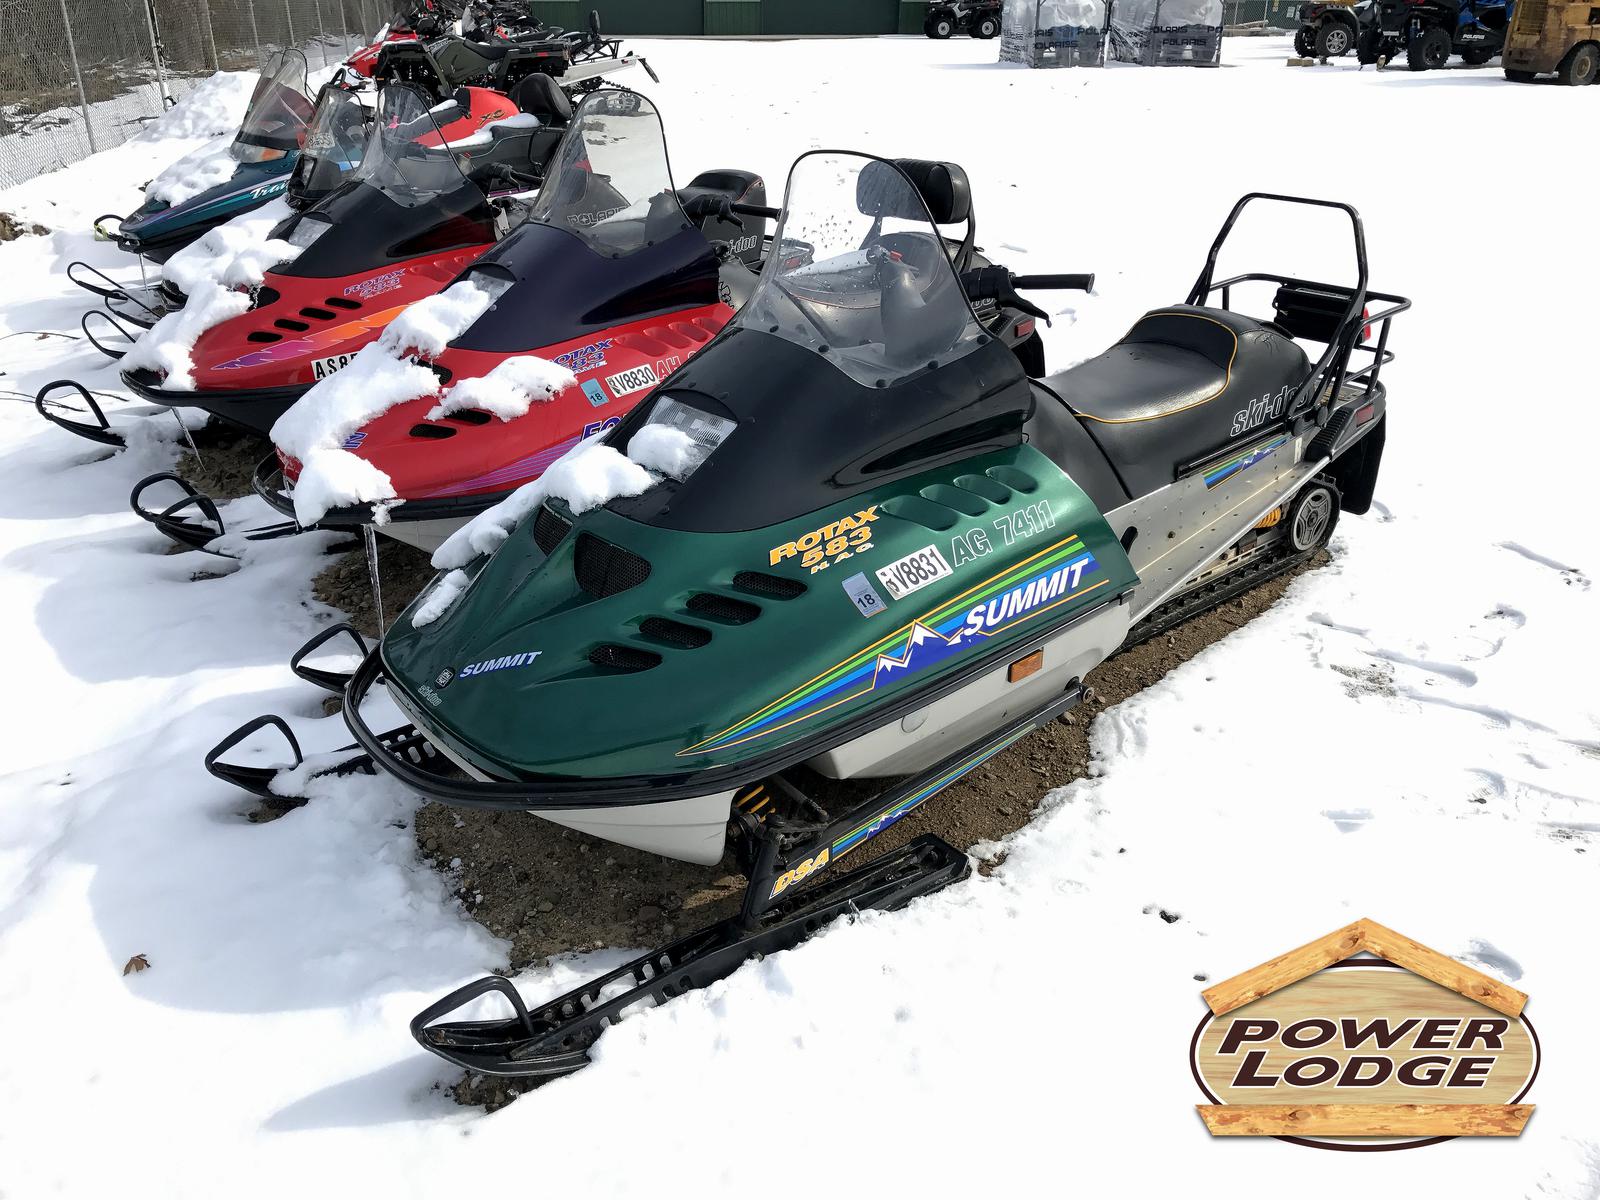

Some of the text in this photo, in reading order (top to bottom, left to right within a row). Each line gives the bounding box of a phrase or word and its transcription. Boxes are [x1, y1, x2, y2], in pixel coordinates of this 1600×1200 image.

[1162, 38, 1207, 46] POLARIS
[343, 268, 407, 297] ROTAX
[553, 337, 614, 365] OTAX
[590, 392, 603, 402] 18
[769, 505, 880, 567] ROTAX
[800, 526, 873, 568] 583
[951, 528, 993, 568] AG
[993, 500, 1056, 546] 7411
[857, 594, 876, 608] 18
[963, 558, 1090, 637] SUMMIT
[459, 651, 543, 679] SUMMIT
[769, 848, 830, 900] DSA
